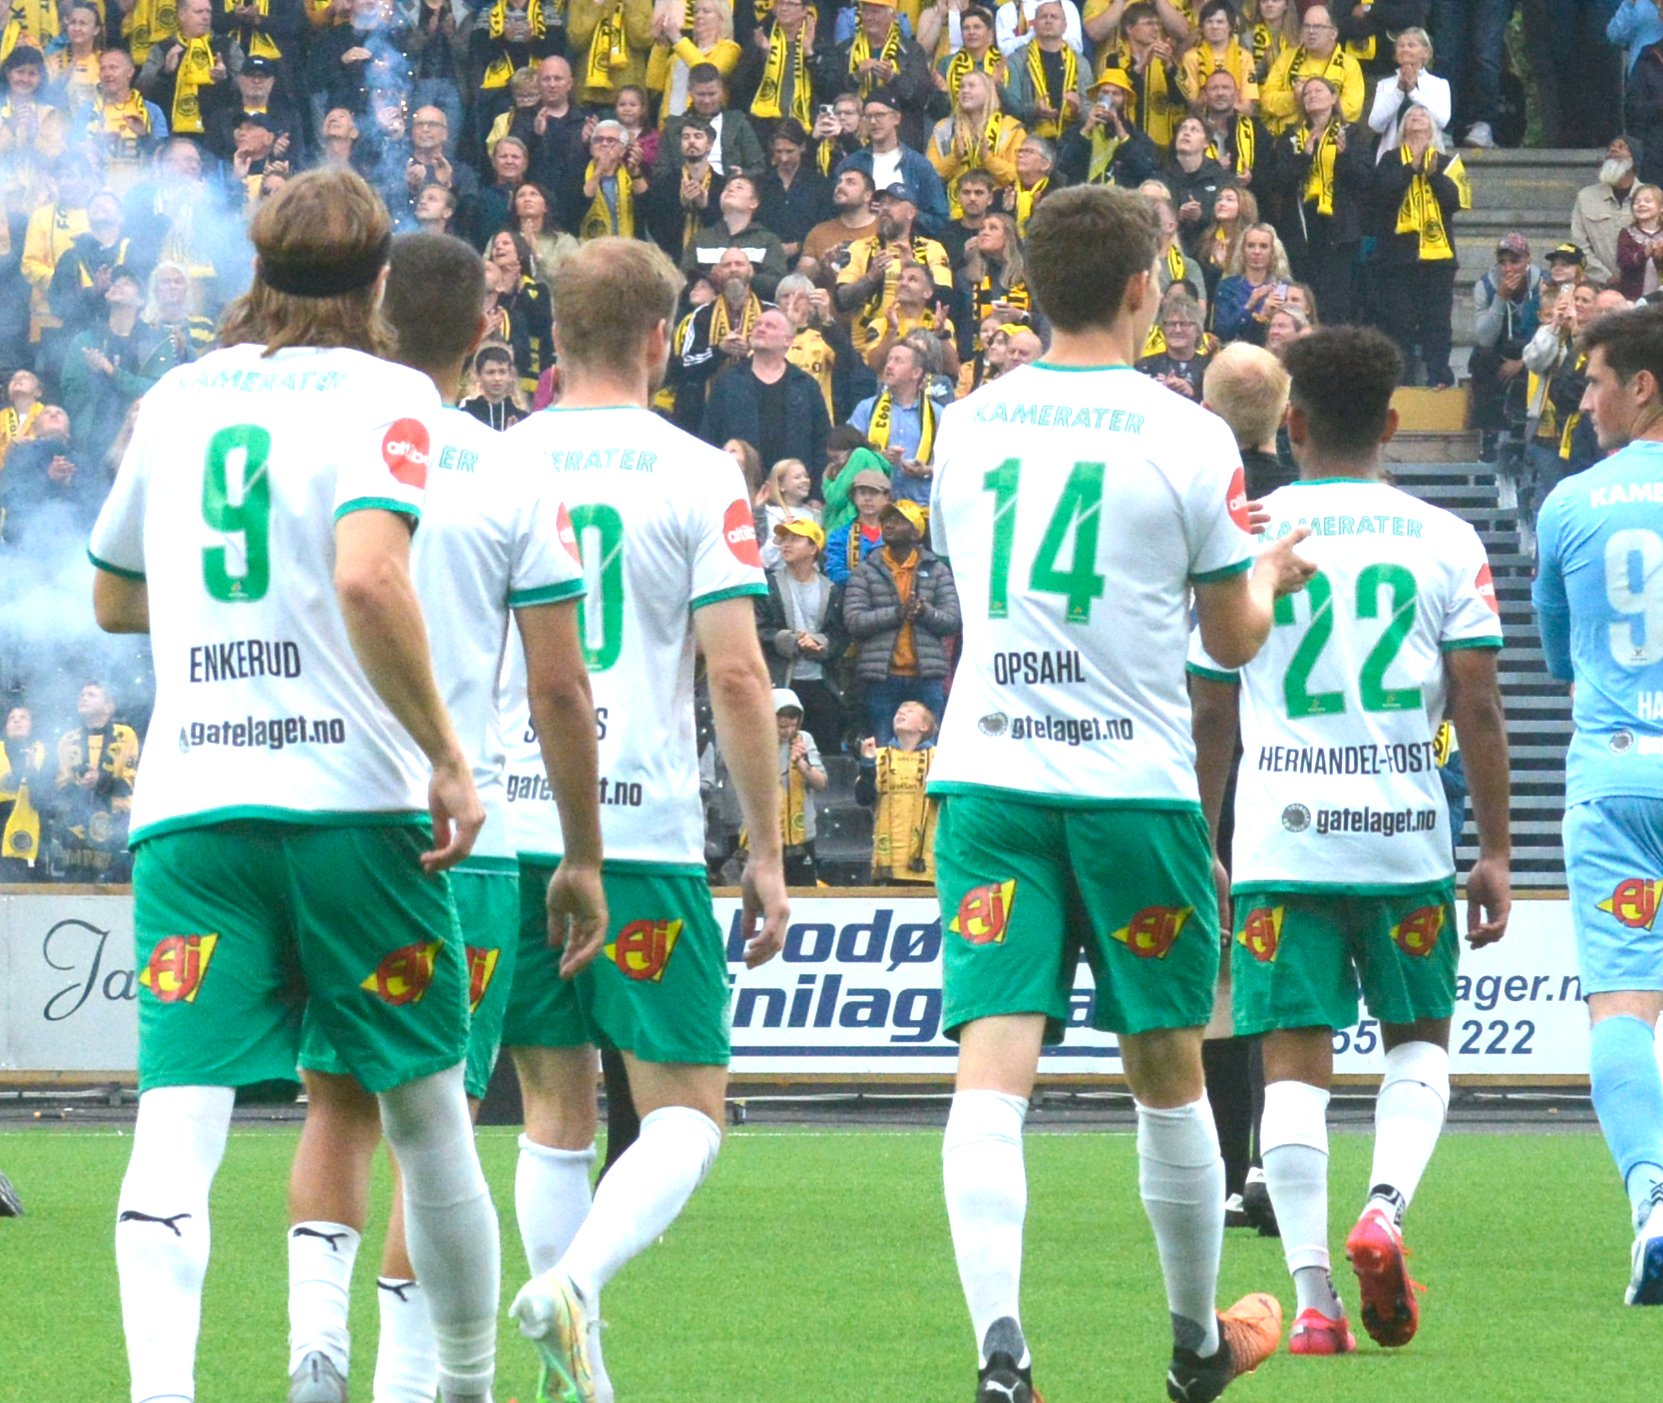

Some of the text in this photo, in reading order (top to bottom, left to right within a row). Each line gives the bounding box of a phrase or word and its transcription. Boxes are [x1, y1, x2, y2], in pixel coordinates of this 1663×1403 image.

[971, 403, 1147, 435] KAMERATER
[202, 423, 272, 603] 9
[982, 457, 1107, 625] 14
[1273, 562, 1424, 720] 22
[189, 639, 301, 683] ENKERUD
[993, 650, 1086, 686] OPSAHL
[190, 714, 346, 750] gatelaget.no
[1315, 806, 1437, 837] gatelaget.no
[1454, 975, 1583, 1011] ager.n
[1458, 1019, 1537, 1055] 222
